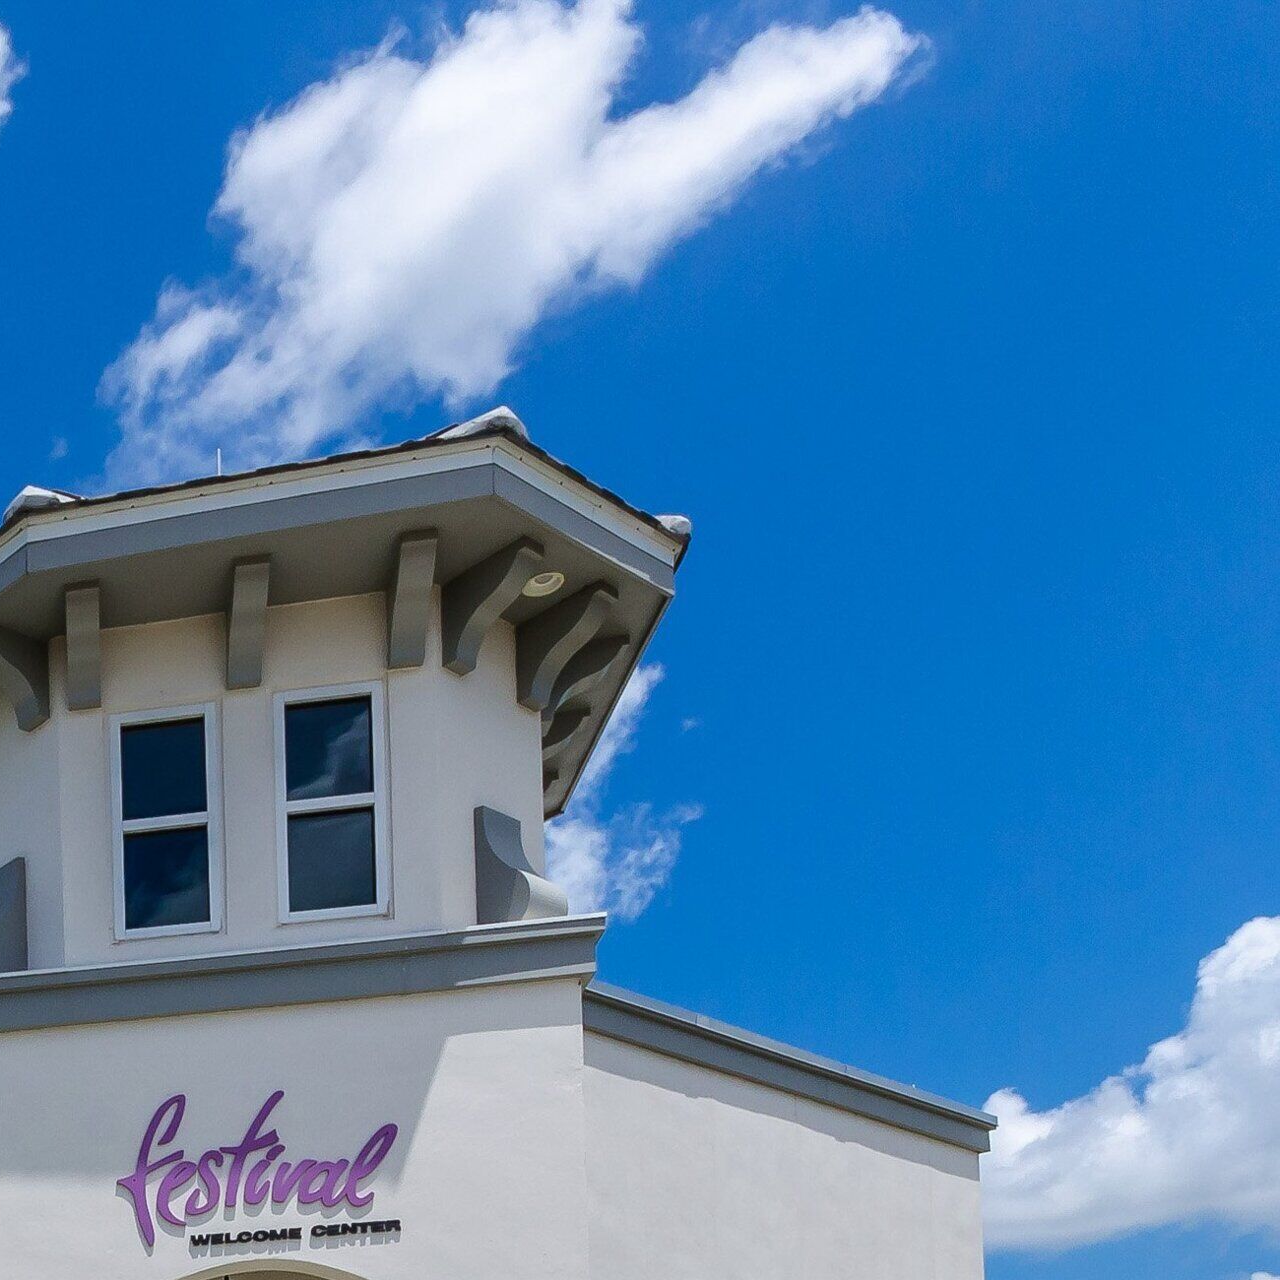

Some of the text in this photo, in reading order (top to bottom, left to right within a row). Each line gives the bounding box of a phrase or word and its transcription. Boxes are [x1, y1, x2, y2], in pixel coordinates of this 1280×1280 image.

[116, 1090, 398, 1247] festival
[190, 1219, 401, 1247] WELCOME CENTER
